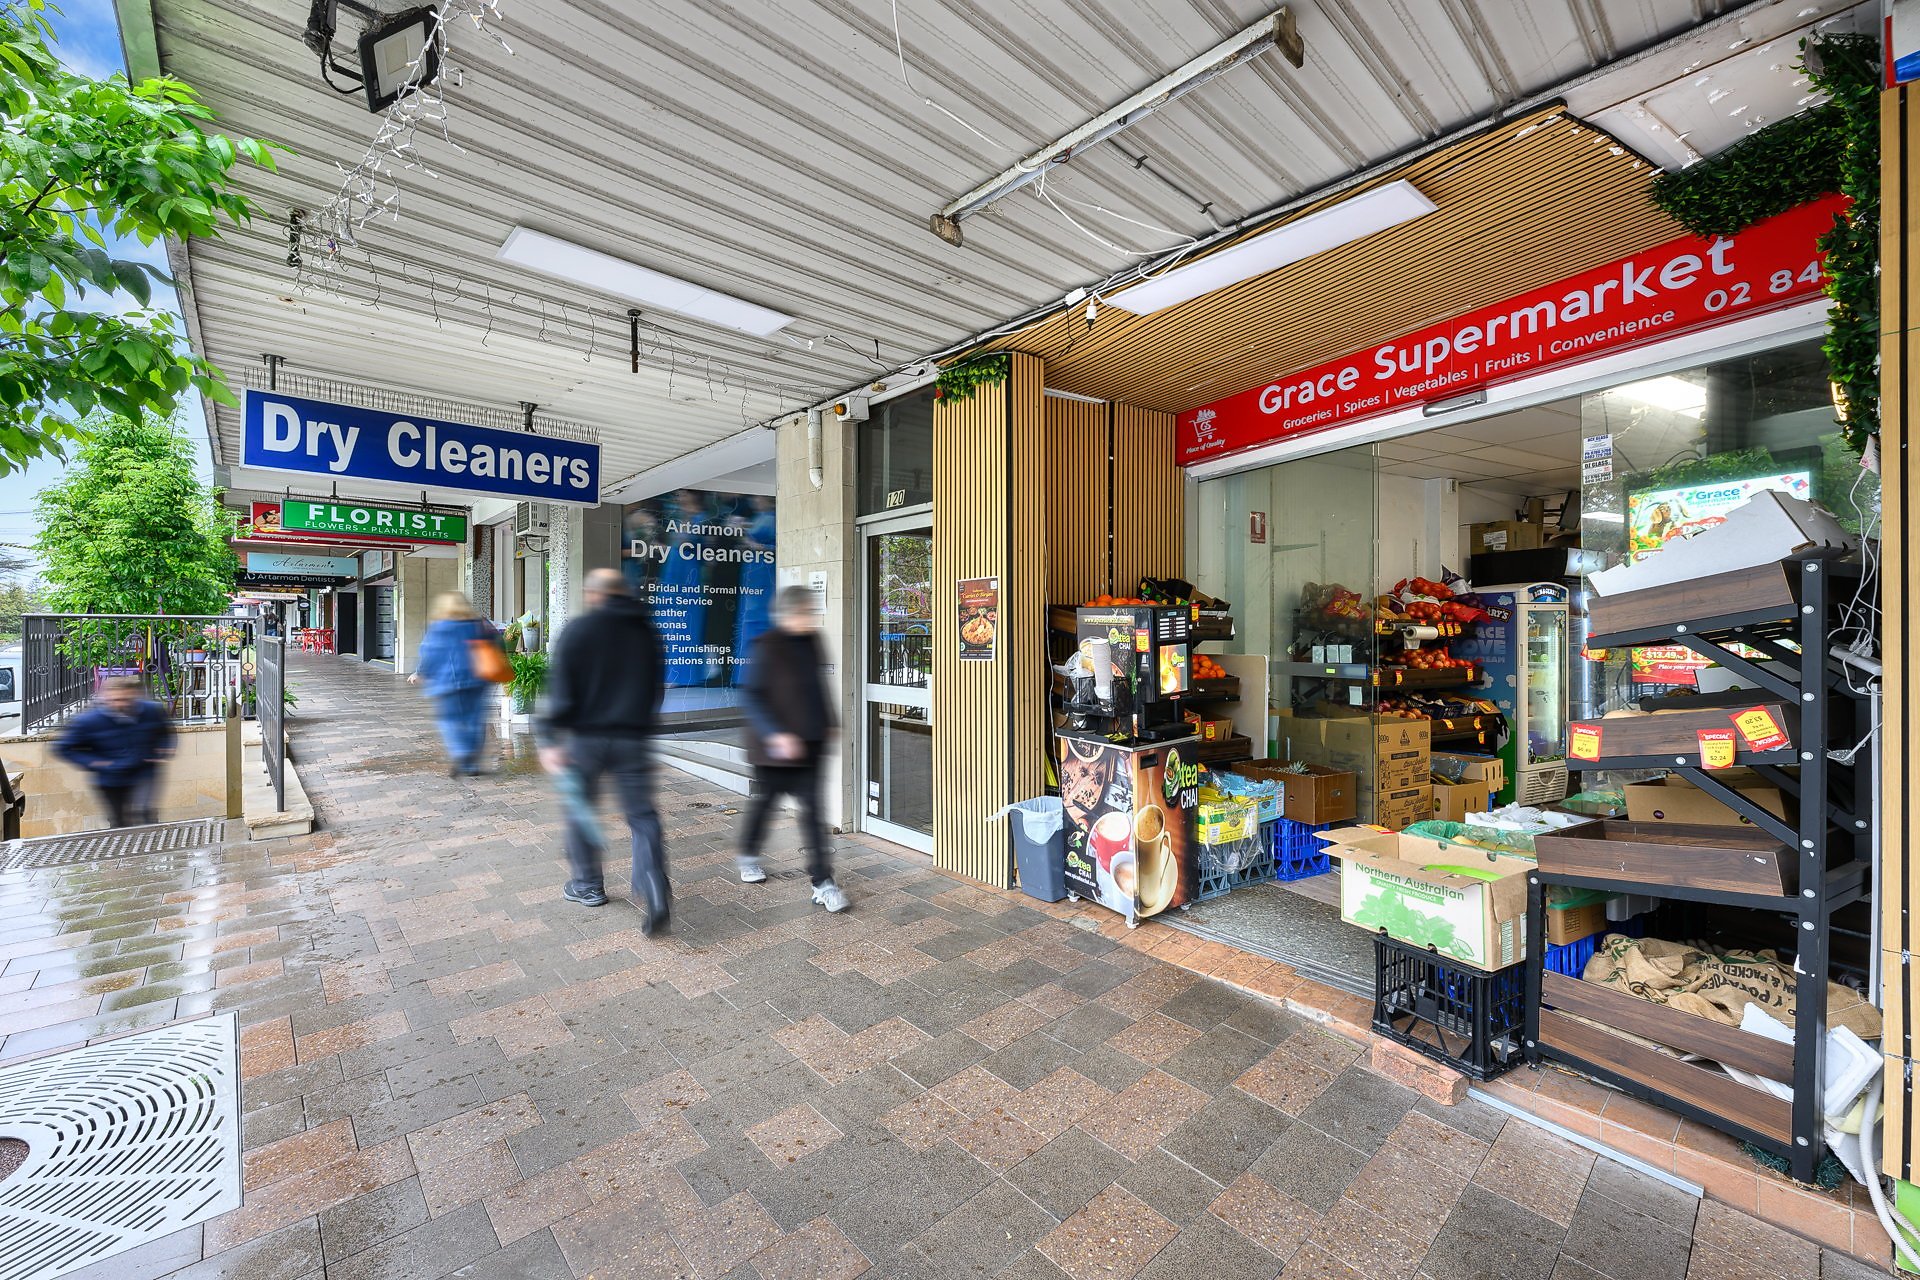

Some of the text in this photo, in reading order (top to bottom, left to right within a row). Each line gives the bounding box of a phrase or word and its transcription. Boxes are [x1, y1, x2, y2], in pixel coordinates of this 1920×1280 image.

[1703, 282, 1751, 313] 02
[1258, 236, 1735, 414] Grace Supermarket
[1283, 308, 1676, 430] Groceries Spices Vegetables Fruits Convenience
[262, 401, 591, 490] Dry Cleaners
[888, 491, 904, 507] 120
[1695, 488, 1740, 500] Grace
[309, 504, 446, 531] FLORIST
[305, 521, 449, 538] FLOWERS PLANTS GIFTS
[666, 520, 743, 537] Artarmon
[631, 539, 775, 564] Dry Cleaners
[257, 573, 300, 581] Artarmon
[648, 583, 764, 595] Bridal and Formal Wear
[648, 596, 713, 606] Shirt Service
[655, 621, 687, 629] oonas
[661, 633, 691, 641] rtains
[1119, 632, 1131, 643] tea
[672, 645, 731, 654] Furnishings
[1119, 642, 1131, 650] CHAI
[1461, 640, 1506, 655] OVE
[664, 657, 703, 665] erations
[706, 657, 724, 665] and
[1576, 728, 1598, 736] SPECIAL
[1755, 735, 1779, 746] SPECIAL
[1180, 761, 1198, 789] tea
[1180, 789, 1198, 810] CHAI
[1078, 859, 1092, 873] tea
[1078, 869, 1092, 879] CHAI
[1355, 862, 1464, 901] Northern Australian
[1722, 964, 1768, 983] PACKED
[1701, 973, 1770, 1004] POTATOES
[1771, 975, 1780, 988] &
